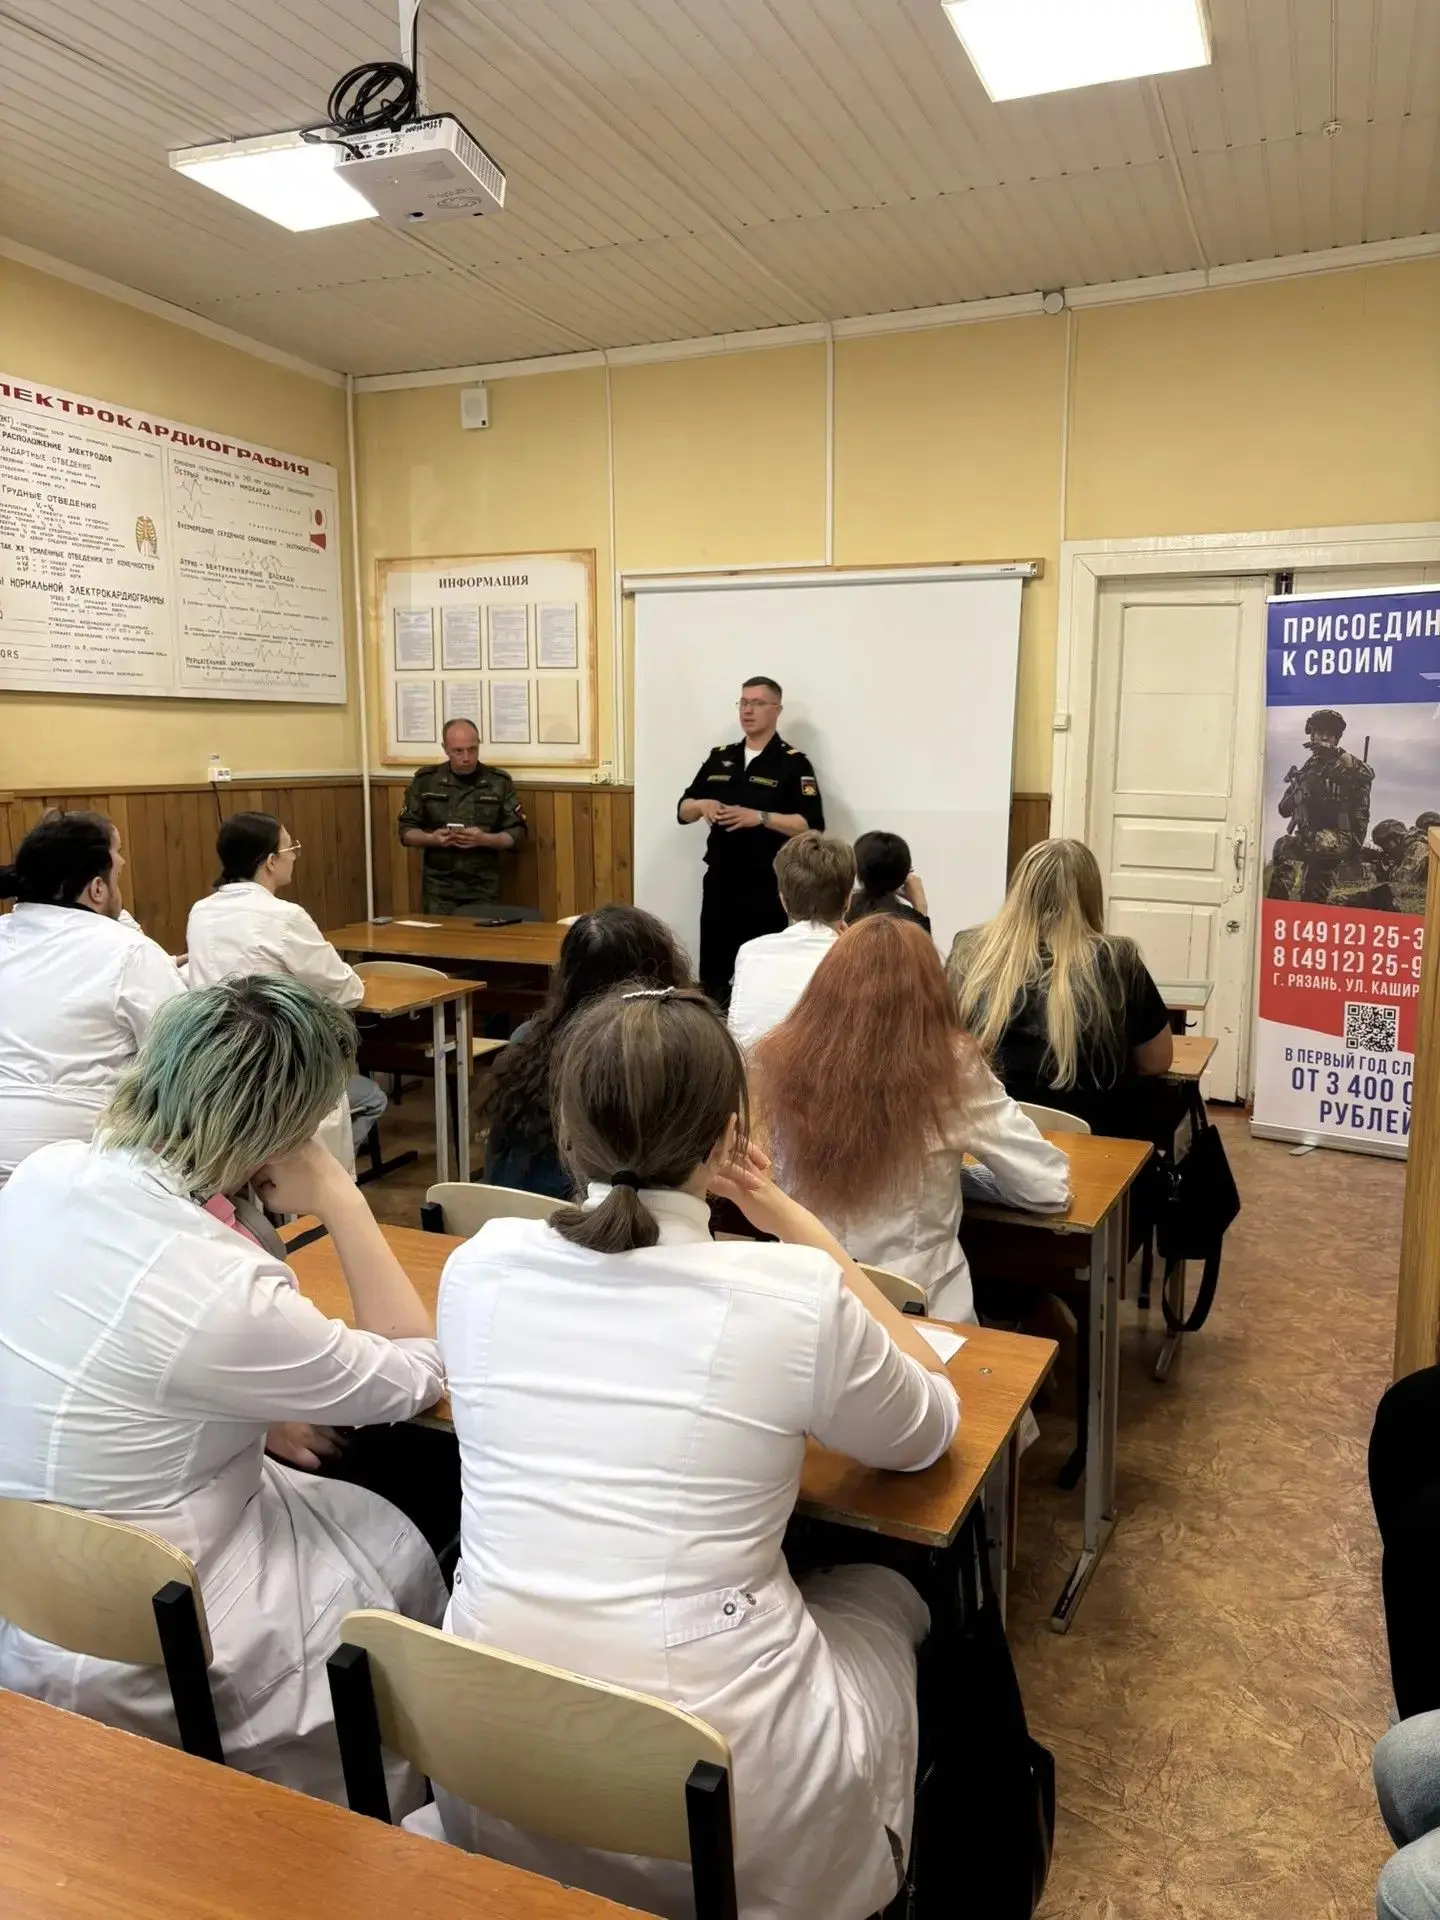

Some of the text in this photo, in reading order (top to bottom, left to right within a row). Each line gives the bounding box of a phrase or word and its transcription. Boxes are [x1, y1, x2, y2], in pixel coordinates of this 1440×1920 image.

[2, 430, 62, 450] РАСПОЛОЖЕНИЕ
[68, 446, 113, 463] ЭЛЕКТРОДОВ
[51, 456, 92, 471] ОТВЕДЕНИЯ
[2, 484, 97, 510] ГРУДНЫЕ ОТВЕДЕНИЯ
[10, 578, 63, 593] НОРМАЛЬНОЙ
[69, 585, 165, 605] ЭЛЕКТРОКАРДИОГРАММЫ
[439, 575, 529, 588] ИНФОРМАЦИЯ
[1283, 609, 1440, 644] ПРИСОЕДИН
[1282, 646, 1393, 676] К СВОИМ
[1274, 919, 1286, 941] 8
[1292, 920, 1366, 946] (4912)
[1273, 946, 1285, 967] 8
[1291, 947, 1364, 973] (4912)
[1273, 973, 1284, 986] Г.
[1345, 978, 1368, 994] УЛ.
[1371, 981, 1420, 998] КАШИР
[1285, 1048, 1412, 1077] В ПЕРВЫЙ ГОД СЛ
[1292, 1067, 1319, 1092] ОТ
[1326, 1071, 1339, 1096] 3
[1347, 1075, 1394, 1102] 400
